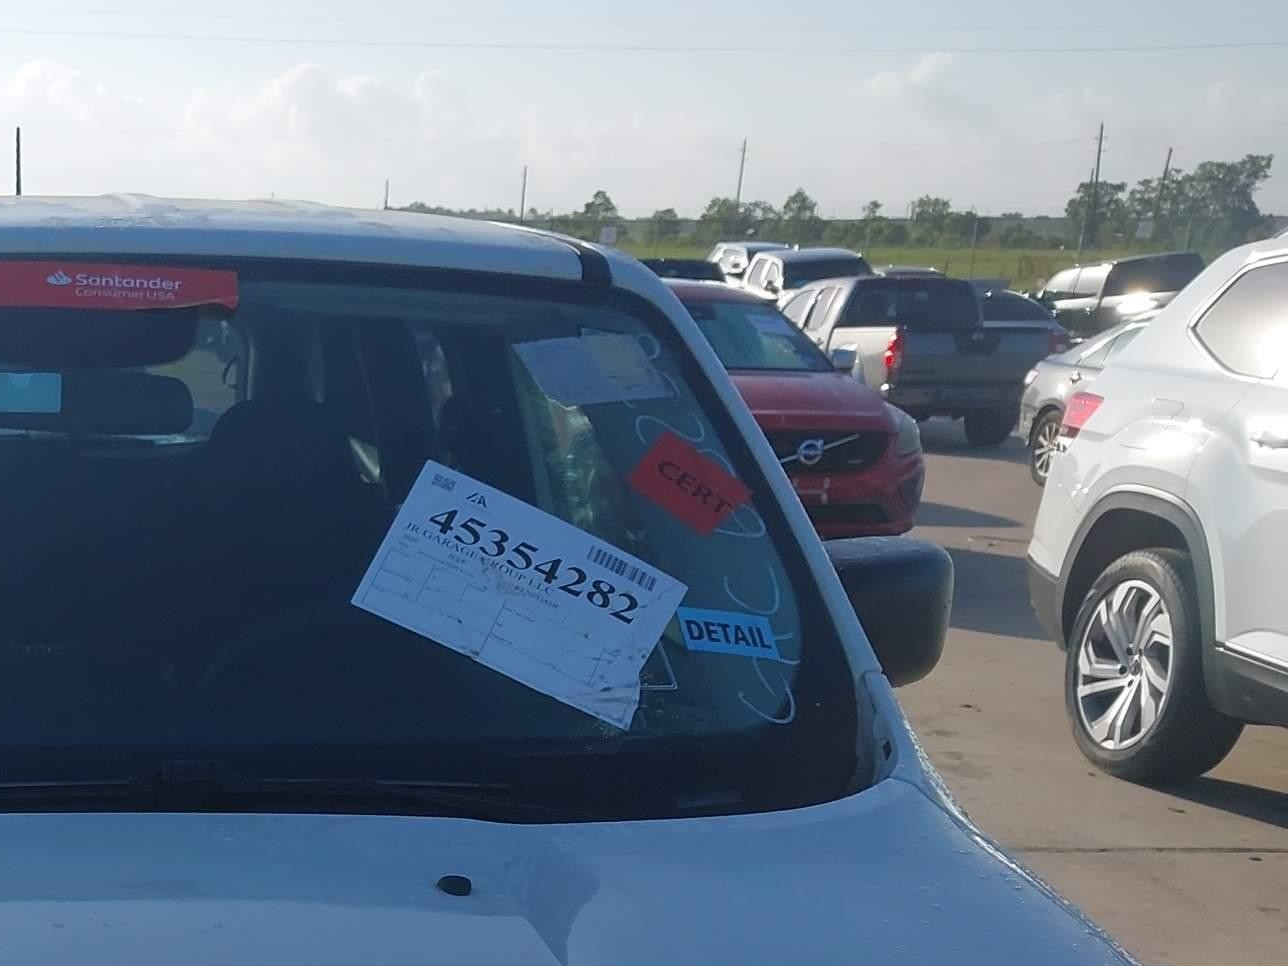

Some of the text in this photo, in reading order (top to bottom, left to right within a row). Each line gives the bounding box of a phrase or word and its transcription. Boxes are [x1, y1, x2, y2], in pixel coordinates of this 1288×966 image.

[75, 273, 182, 291] Santander
[75, 286, 176, 301] Consumer USA
[657, 459, 733, 516] CERT
[422, 529, 479, 560] GARAGE
[429, 508, 639, 625] 45354282
[685, 618, 773, 651] DETAIL
